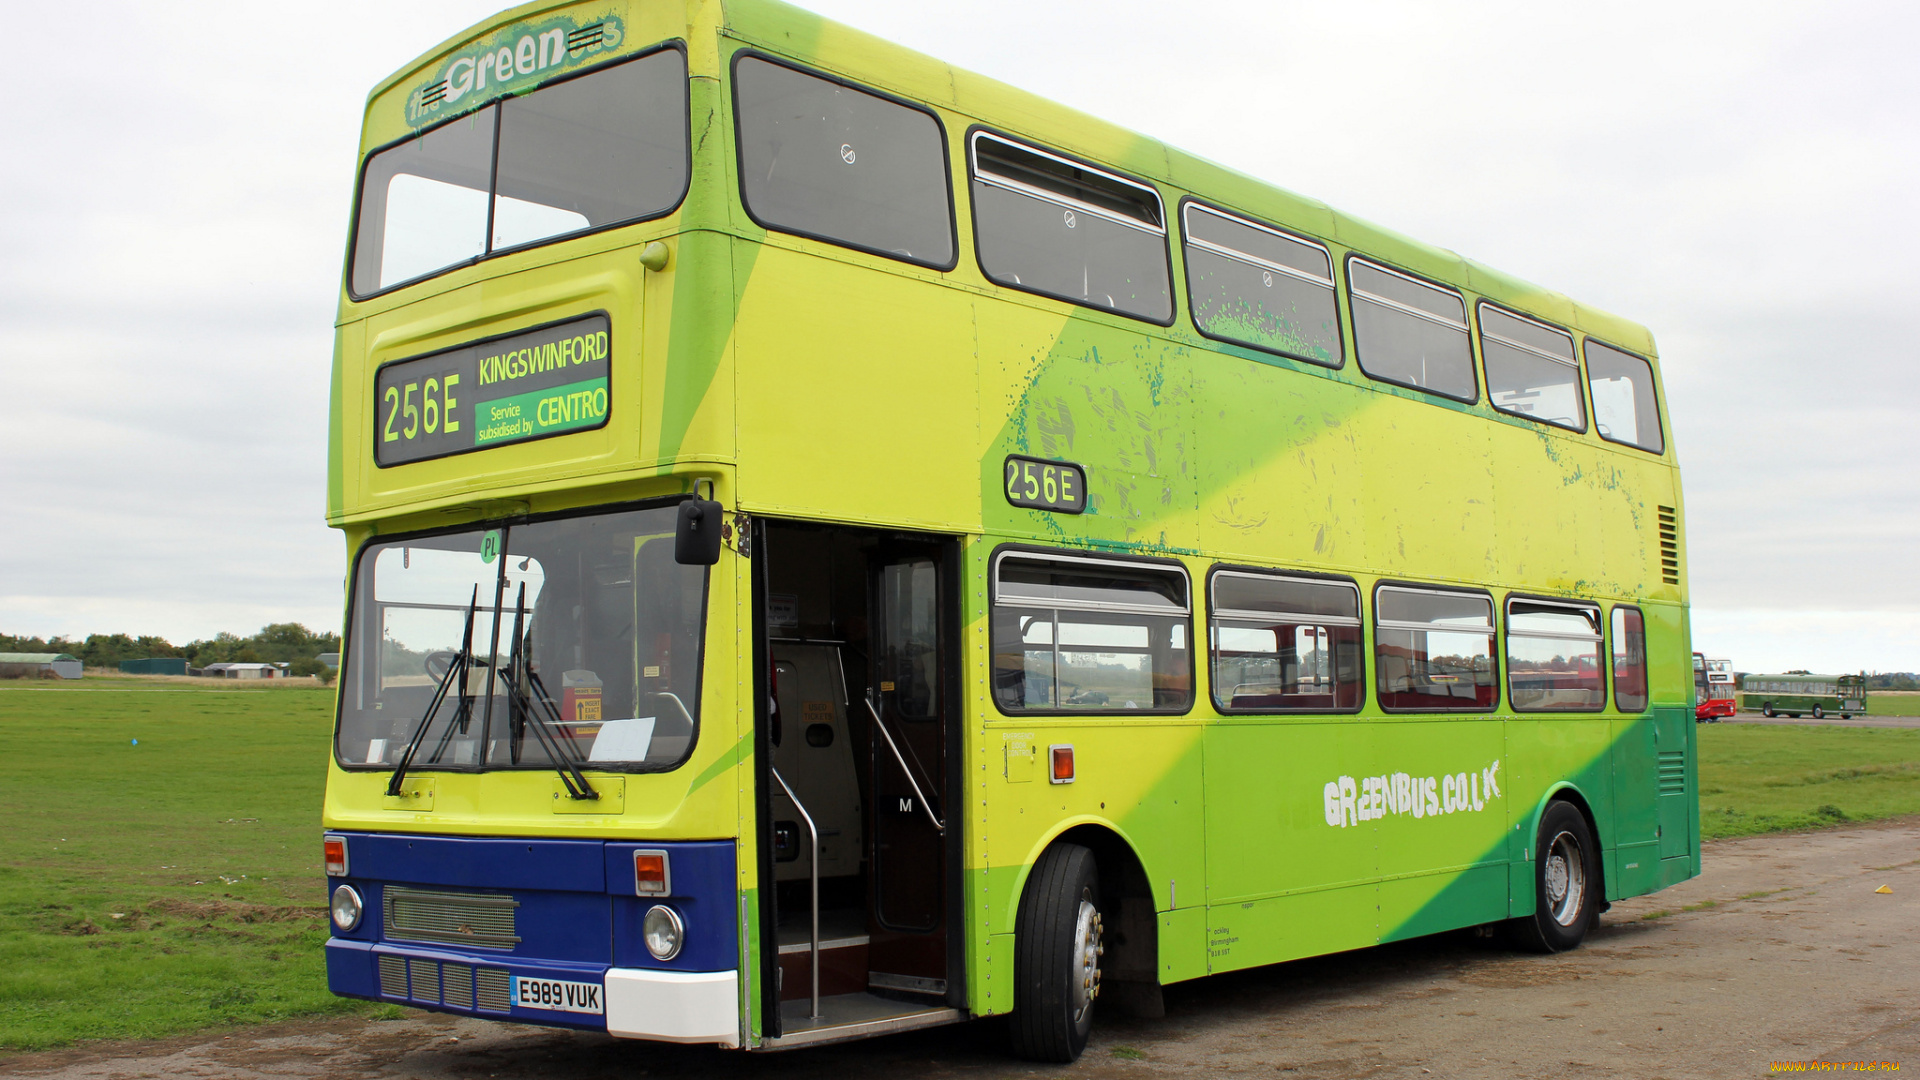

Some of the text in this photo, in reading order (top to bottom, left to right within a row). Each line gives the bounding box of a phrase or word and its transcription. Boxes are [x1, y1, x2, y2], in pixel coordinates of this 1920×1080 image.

[442, 27, 566, 103] Green
[479, 331, 608, 385] KINGSWINFORD
[384, 374, 460, 443] 256E
[491, 403, 521, 421] Service
[536, 387, 608, 427] CENTRO
[479, 418, 534, 441] subsidised by
[1007, 459, 1075, 504] 256E
[484, 537, 496, 557] PL
[803, 712, 833, 720] TICKETS
[808, 703, 827, 711] USED
[900, 798, 912, 812] M
[1211, 936, 1239, 946] Birmingham
[520, 980, 599, 1009] E989 VUK
